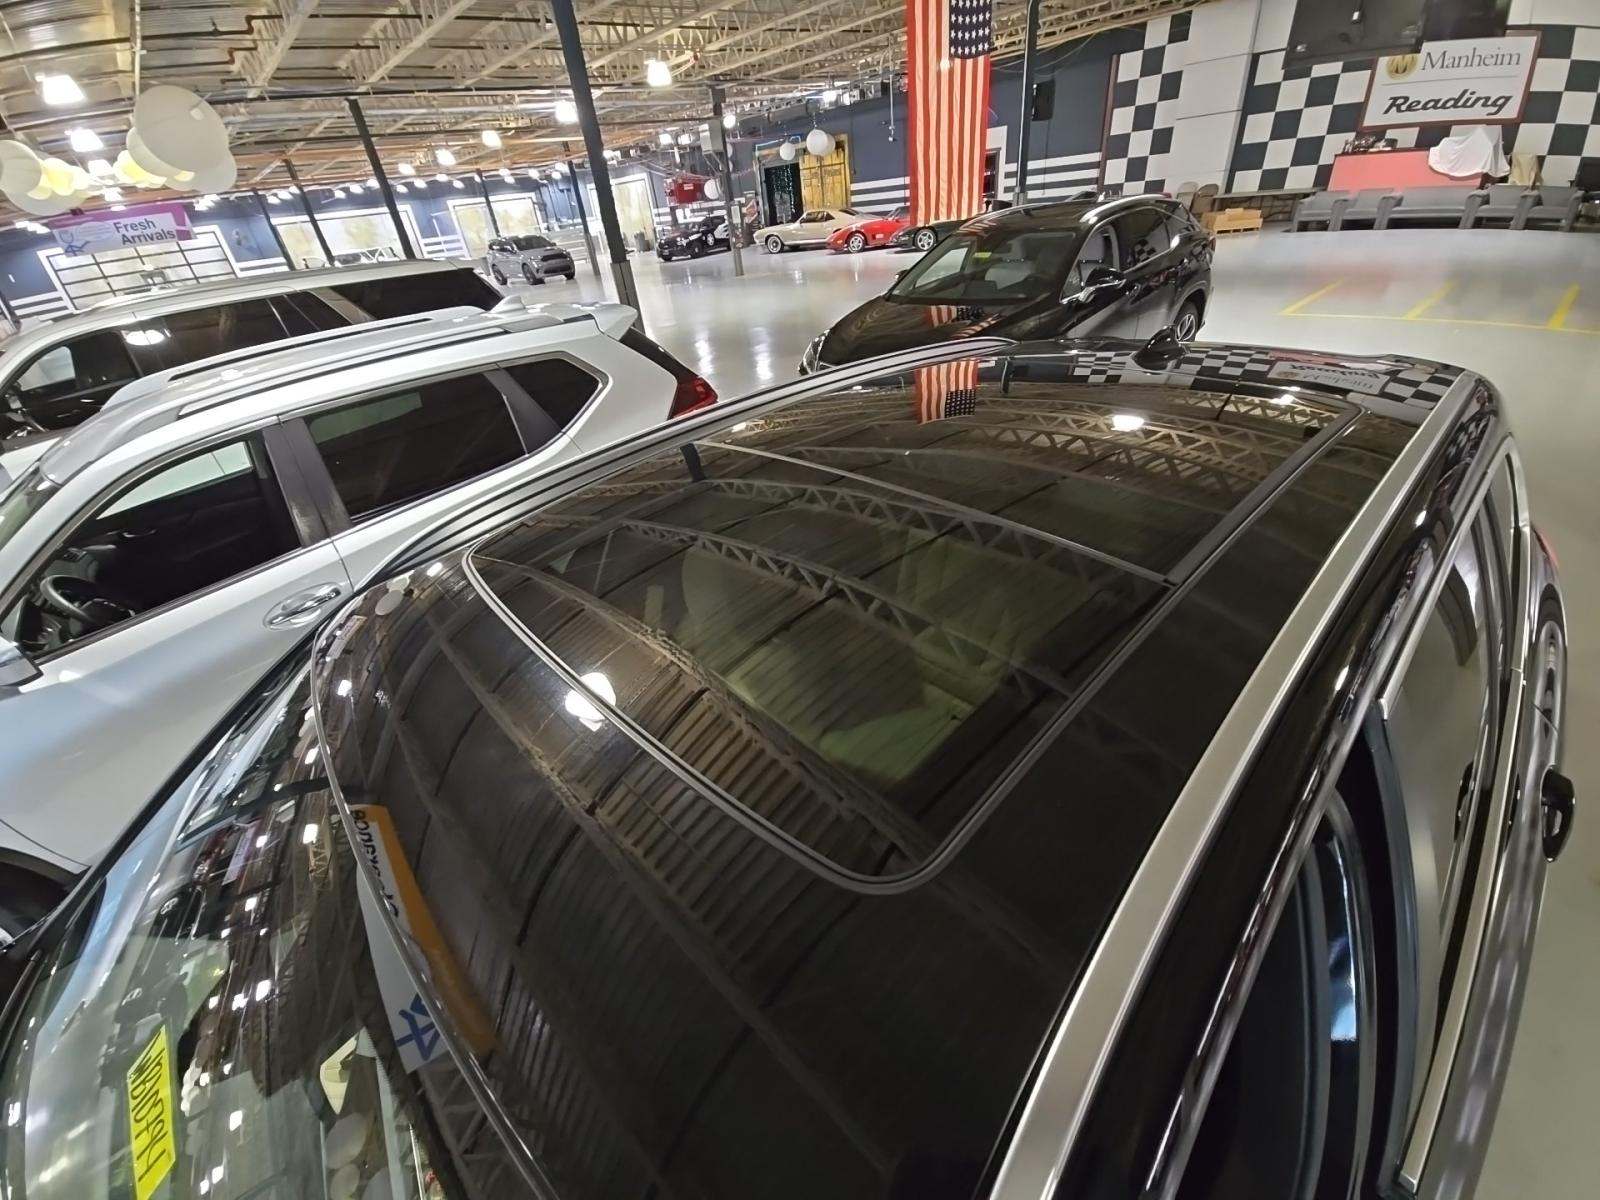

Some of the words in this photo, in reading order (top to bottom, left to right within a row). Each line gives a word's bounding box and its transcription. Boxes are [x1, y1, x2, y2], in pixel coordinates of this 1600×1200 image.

[1420, 46, 1522, 71] Manheim
[1382, 88, 1514, 117] Reading
[113, 218, 157, 234] Fresh
[121, 228, 177, 246] Arrivals
